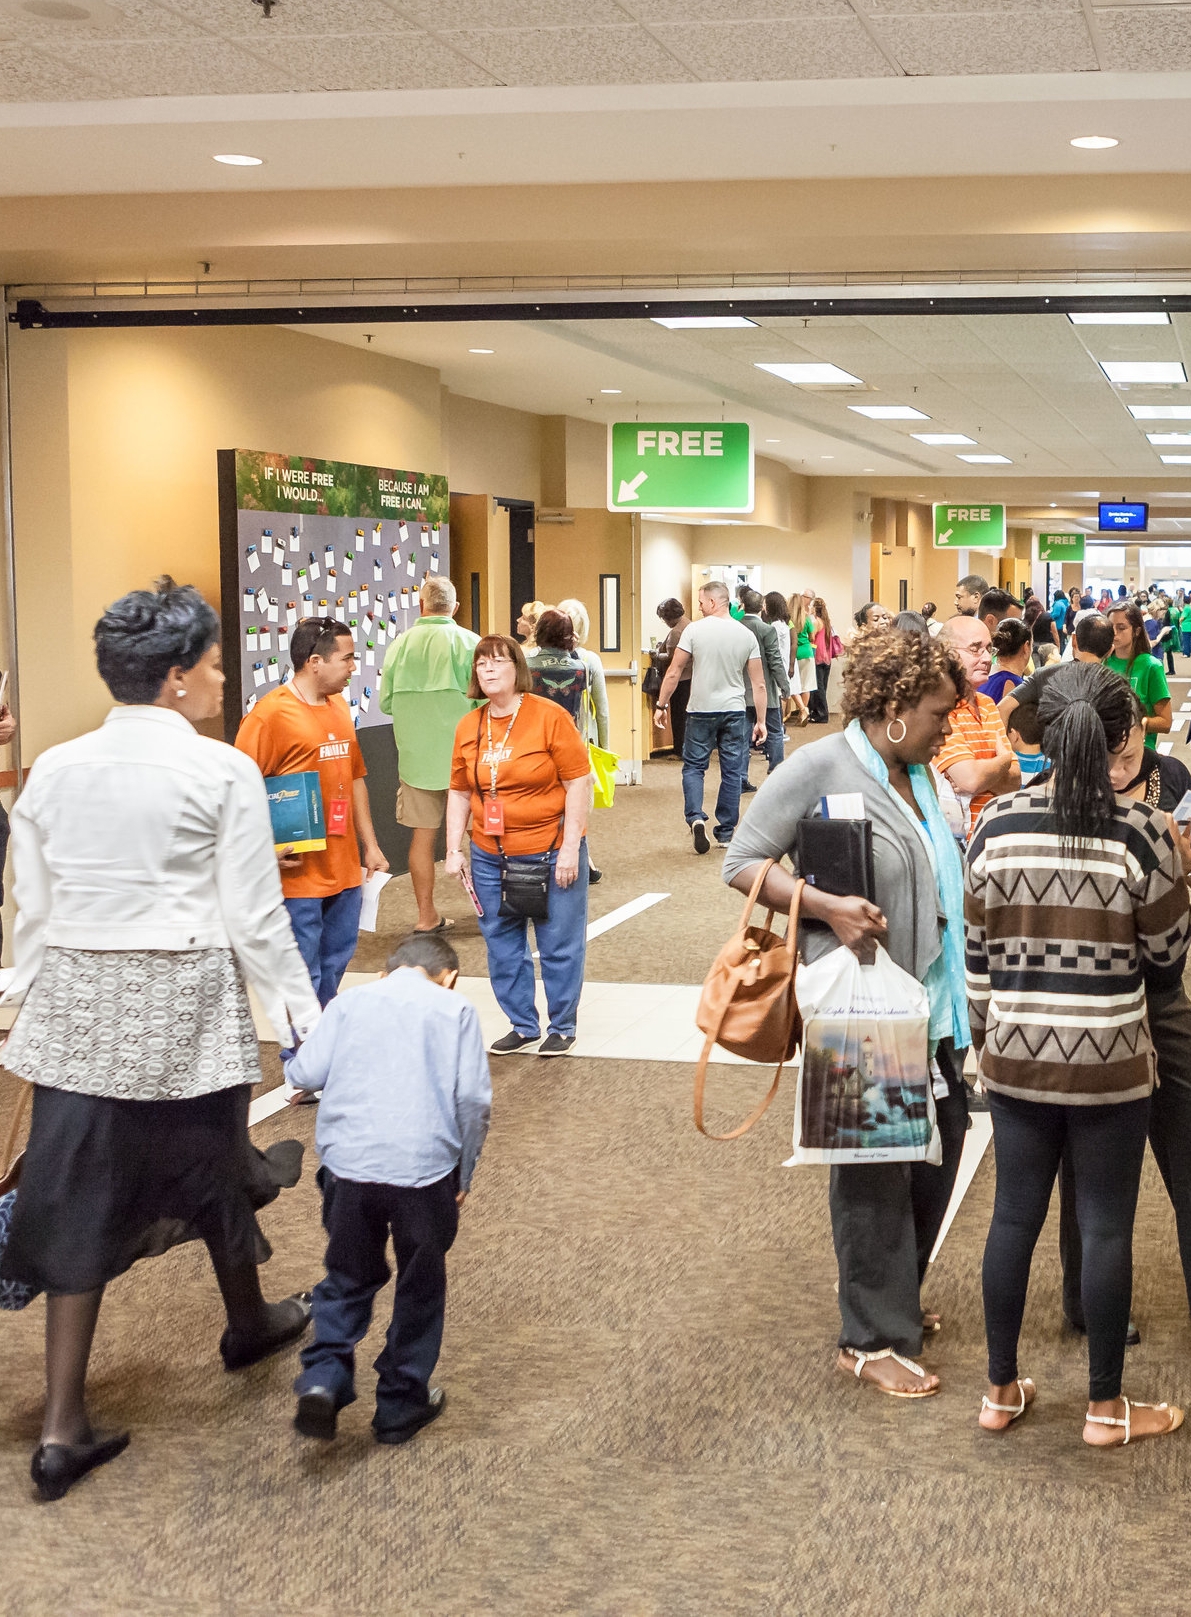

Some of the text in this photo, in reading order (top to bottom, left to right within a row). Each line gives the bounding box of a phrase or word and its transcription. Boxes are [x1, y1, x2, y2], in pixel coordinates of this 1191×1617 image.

[637, 430, 724, 456] FREE
[264, 467, 334, 487] IF I WERE FREE
[277, 485, 324, 502] I WOULD...
[378, 479, 412, 495] BECAUSE
[418, 484, 429, 496] AM
[381, 495, 400, 508] FREE
[406, 497, 427, 511] CAN...
[947, 508, 991, 522] FREE
[1047, 535, 1077, 545] FREE
